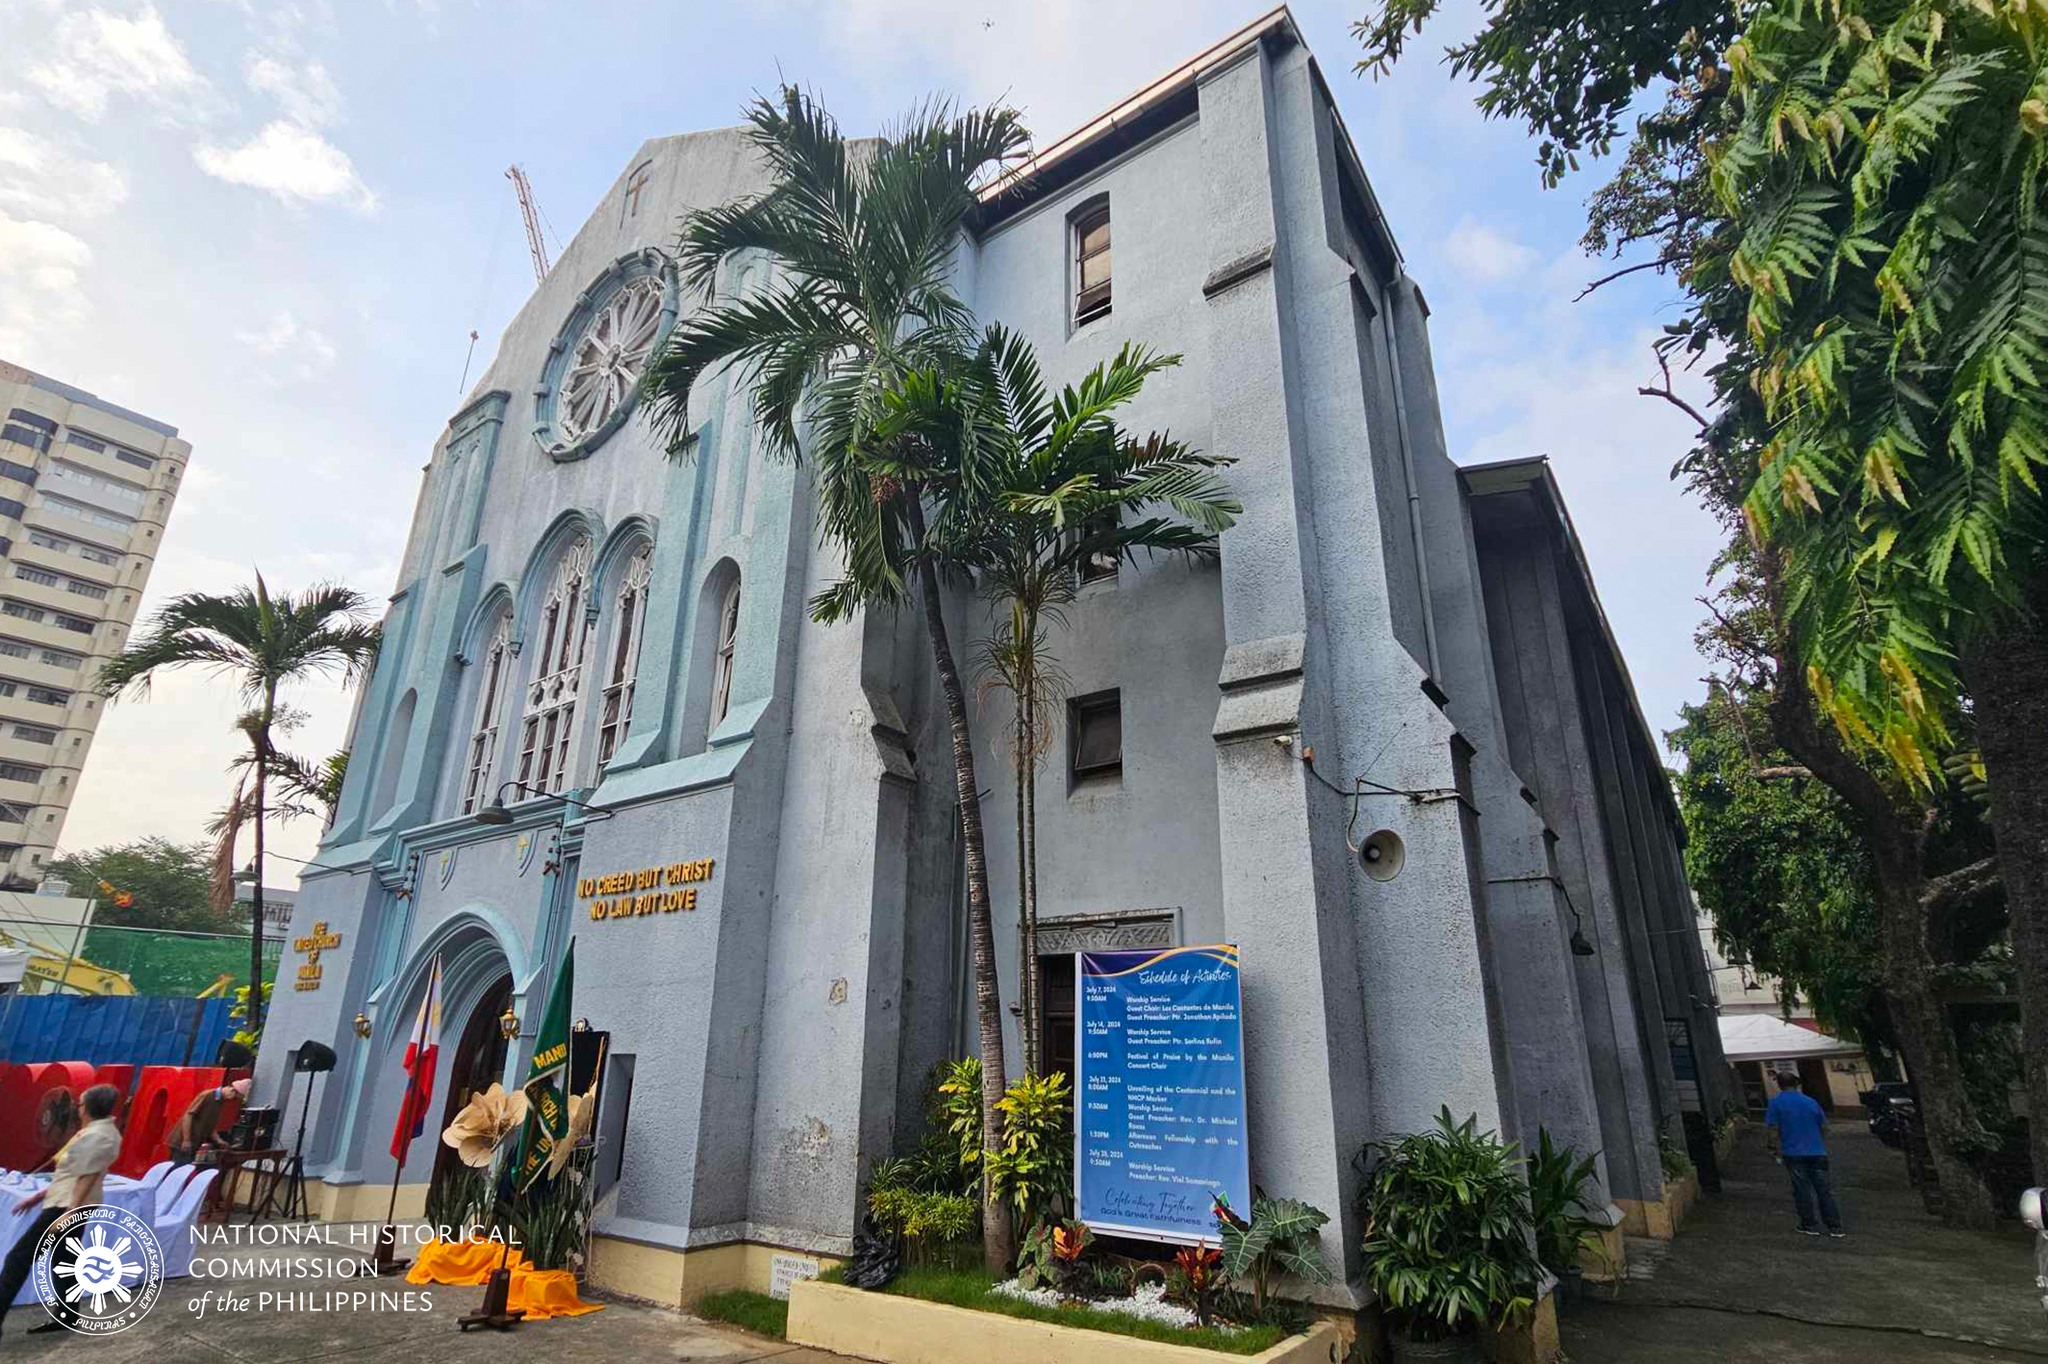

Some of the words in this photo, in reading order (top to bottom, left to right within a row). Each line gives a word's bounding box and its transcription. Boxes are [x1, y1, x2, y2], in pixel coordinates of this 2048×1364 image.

[578, 879, 593, 897] NO
[597, 870, 634, 894] CREED
[637, 867, 661, 888] BUT
[664, 857, 714, 885] CHRIST
[590, 900, 605, 920] NO
[610, 896, 631, 919] LAW
[635, 893, 660, 915] BUT
[662, 889, 696, 912] LOVE
[1138, 970, 1177, 984] Schedule
[1180, 969, 1191, 985] of
[1192, 969, 1232, 983] Activities
[1086, 986, 1097, 994] July
[1086, 1021, 1097, 1030] July
[1127, 1028, 1149, 1036] Worship
[1184, 1053, 1193, 1062] by
[1212, 1053, 1234, 1061] Manila
[1089, 1075, 1099, 1084] July
[1127, 1085, 1154, 1093] Unveiling
[1175, 1086, 1208, 1094] Centennial
[1210, 1087, 1223, 1095] and
[1225, 1087, 1236, 1095] the
[1128, 1104, 1151, 1112] Worship
[1211, 1117, 1238, 1125] Michael
[1128, 1131, 1157, 1140] Afternoon
[1164, 1134, 1196, 1144] Fellowship
[1205, 1136, 1219, 1144] with
[1227, 1137, 1238, 1146] the
[1128, 1141, 1162, 1150] Outreaches
[1089, 1149, 1100, 1158] July
[1109, 1150, 1123, 1158] 2024
[1128, 1162, 1152, 1172] Worship
[1153, 1164, 1175, 1172] Service
[1129, 1172, 1157, 1181] Preacher:
[1105, 1188, 1155, 1210] Celebrating
[1158, 1191, 1195, 1215] Together
[1125, 1209, 1149, 1219] Great
[1150, 1213, 1202, 1226] Faithfulness
